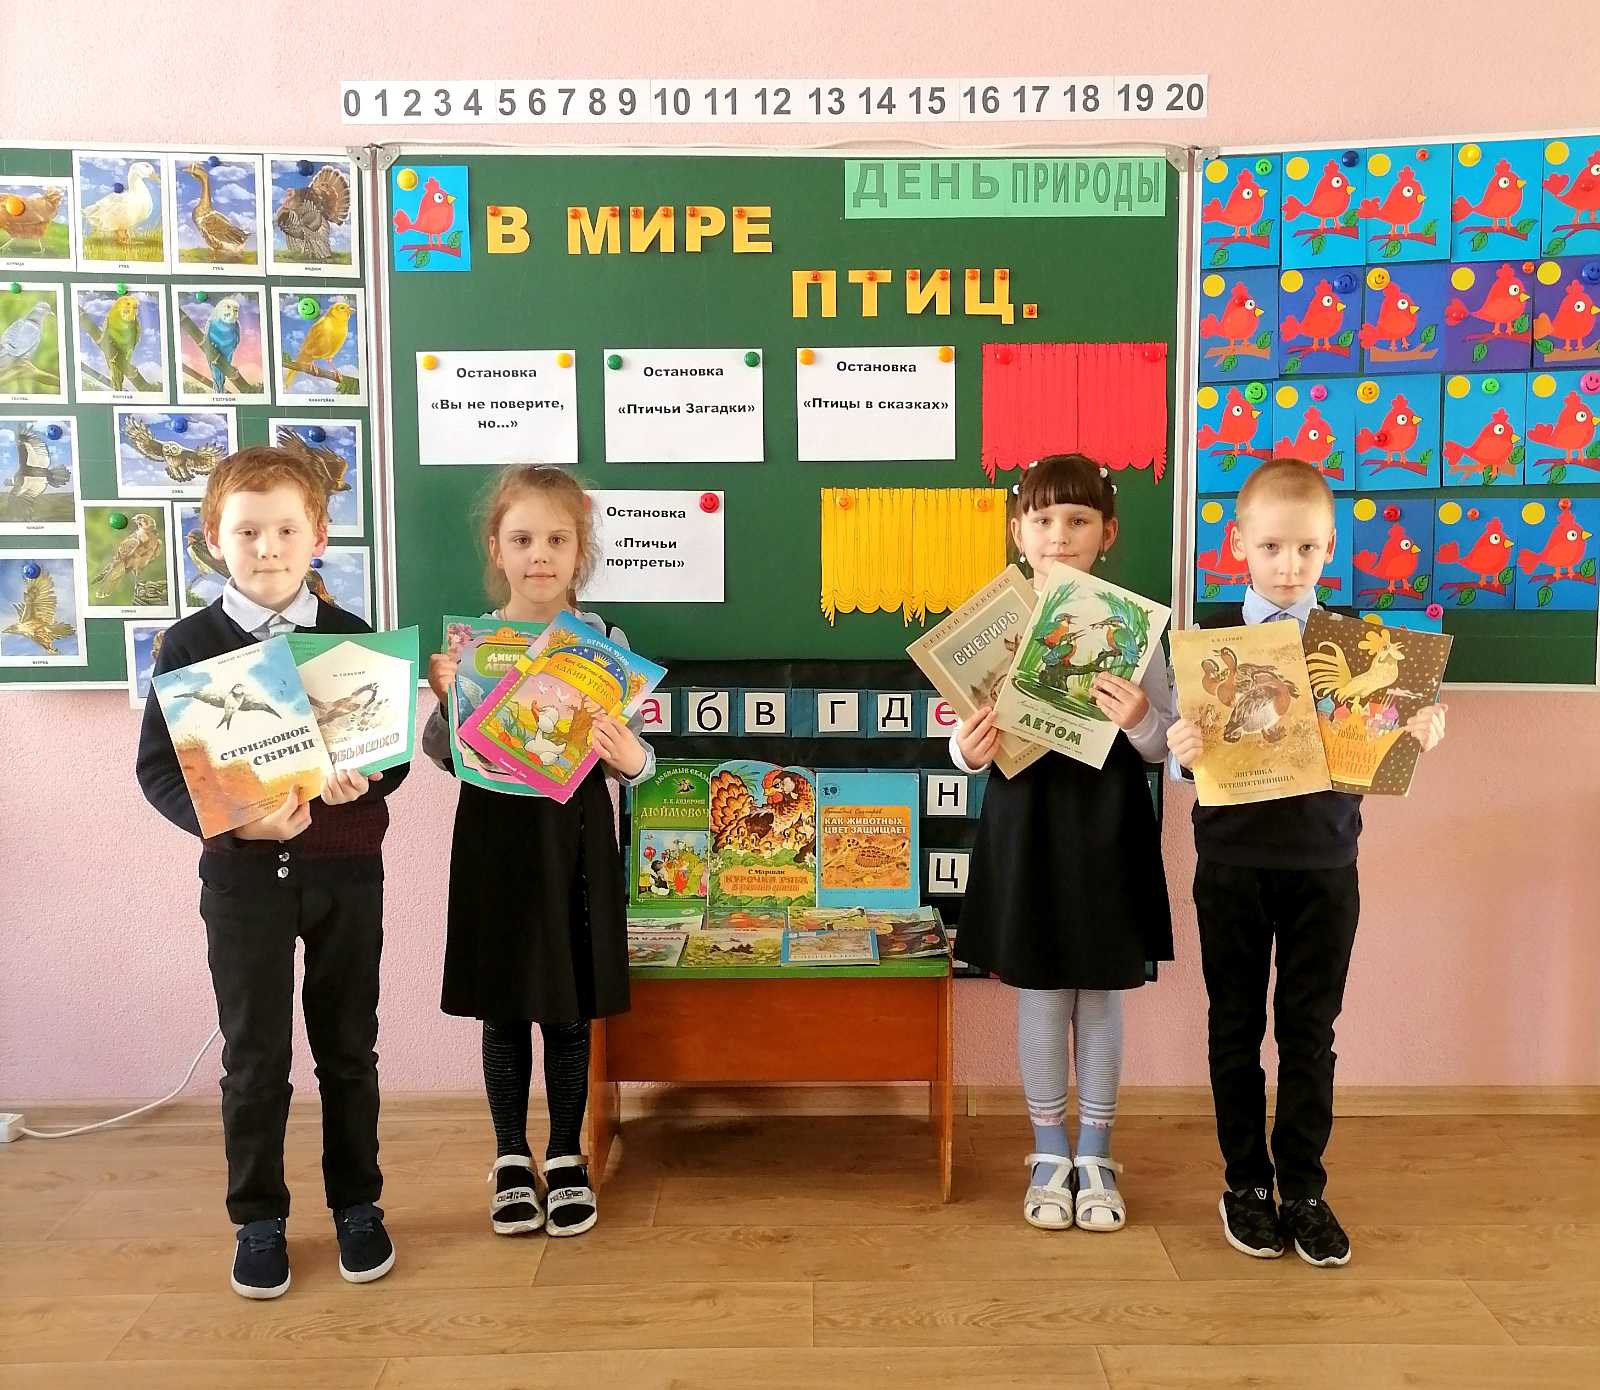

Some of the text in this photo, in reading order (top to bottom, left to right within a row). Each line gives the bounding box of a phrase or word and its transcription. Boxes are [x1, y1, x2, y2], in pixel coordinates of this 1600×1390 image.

[343, 83, 1204, 117] 0 1 2 3 4 5 6 7 8 9 10 11 12 13 14 15 16 17 18 19 20
[852, 161, 1160, 211] ДЕНЬ ПРИРОДЫ
[486, 205, 773, 255] В МИРЕ
[792, 268, 1038, 325] ПТИЦ.
[456, 367, 537, 379] Остановка
[643, 366, 724, 377] Остановка
[836, 361, 917, 373] Остановка
[431, 399, 564, 412] «Вы не поверите,
[618, 402, 755, 415] «Птичьи Загадки»
[803, 397, 949, 411] «Птицы в сказках»
[606, 506, 686, 519] Остановка
[615, 537, 677, 549] «Птичьи
[606, 558, 685, 570] портреты»
[952, 611, 1019, 666] СНЕГИРЬ
[642, 697, 663, 724] а
[696, 691, 722, 730] б
[830, 701, 846, 725] г
[881, 697, 909, 728] д
[1019, 713, 1082, 745] ЛЕТОМ
[220, 725, 311, 761] СТРИЖОНОК
[253, 738, 315, 766] СКРИП
[641, 806, 709, 819] ДЮЙМОВОЧ
[825, 817, 903, 825] КАК ЖИВОТНЫХ
[825, 826, 906, 834] ЦВЕТ ЗАЩИЩАЕТ
